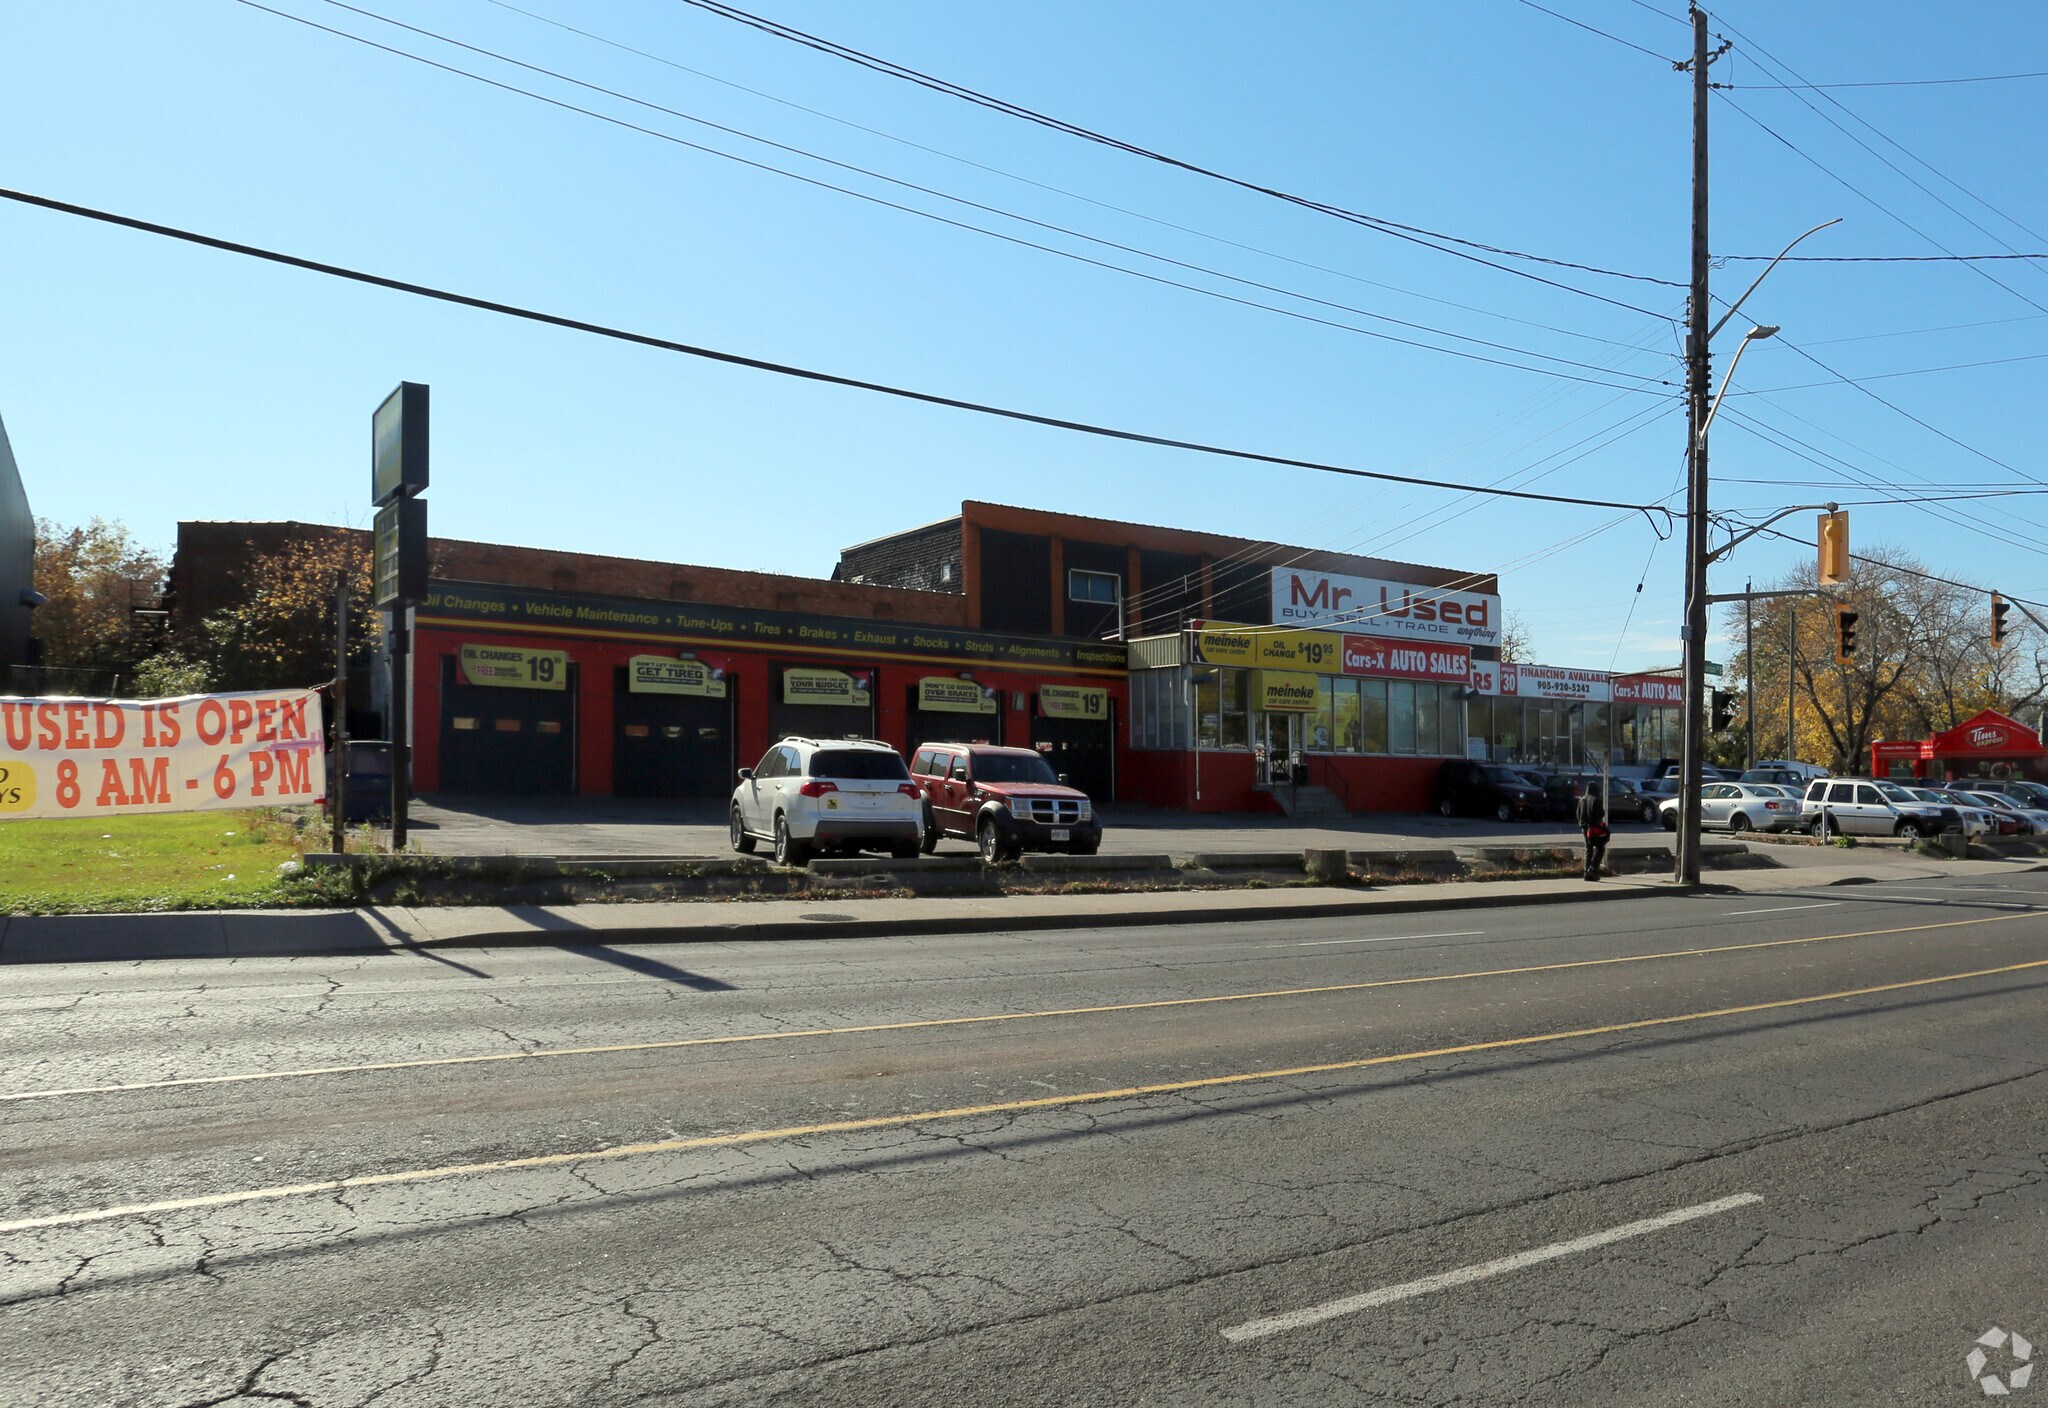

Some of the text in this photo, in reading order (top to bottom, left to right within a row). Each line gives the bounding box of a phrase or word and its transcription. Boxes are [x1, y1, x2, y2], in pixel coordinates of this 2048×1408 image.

[1291, 575, 1488, 627] Mr. Used
[444, 595, 506, 613] Changes
[526, 602, 573, 617] Vehicle
[576, 606, 659, 624] Maintenance
[677, 615, 734, 632] Tune-Ups
[753, 622, 781, 635] Tires
[800, 626, 837, 639] Brakes
[854, 631, 896, 645] Exhaust
[913, 636, 949, 649] Shocks
[965, 640, 995, 653] Struts
[1009, 645, 1060, 659] Alignments
[1077, 650, 1126, 663] Inspections
[1282, 608, 1498, 643] BUY SELL TRADE anything
[1204, 633, 1251, 648] meineke
[1273, 640, 1286, 649] OIL
[464, 648, 523, 662] OIL CHANGES
[1263, 648, 1296, 659] CHANGE
[1345, 649, 1385, 669] Cars-X
[1390, 649, 1427, 672] AUTO
[1430, 652, 1467, 675] SALES
[637, 667, 704, 679] GET TIRED
[1520, 667, 1610, 684] FINANCING AVAILABLE
[790, 680, 849, 690] YOUR BUDGET
[1042, 688, 1051, 697] OIL
[1267, 683, 1314, 699] meineke
[1537, 680, 1591, 693] 905-920-5242
[1642, 682, 1665, 700] AUTO
[948, 690, 978, 698] BRAKES
[1, 698, 308, 751] USED IS OPEN
[1971, 727, 1997, 742] Tims
[1976, 736, 2004, 747] express
[56, 759, 81, 808] 8
[97, 757, 171, 806] AM
[213, 755, 236, 799] 6
[249, 749, 312, 797] PM
